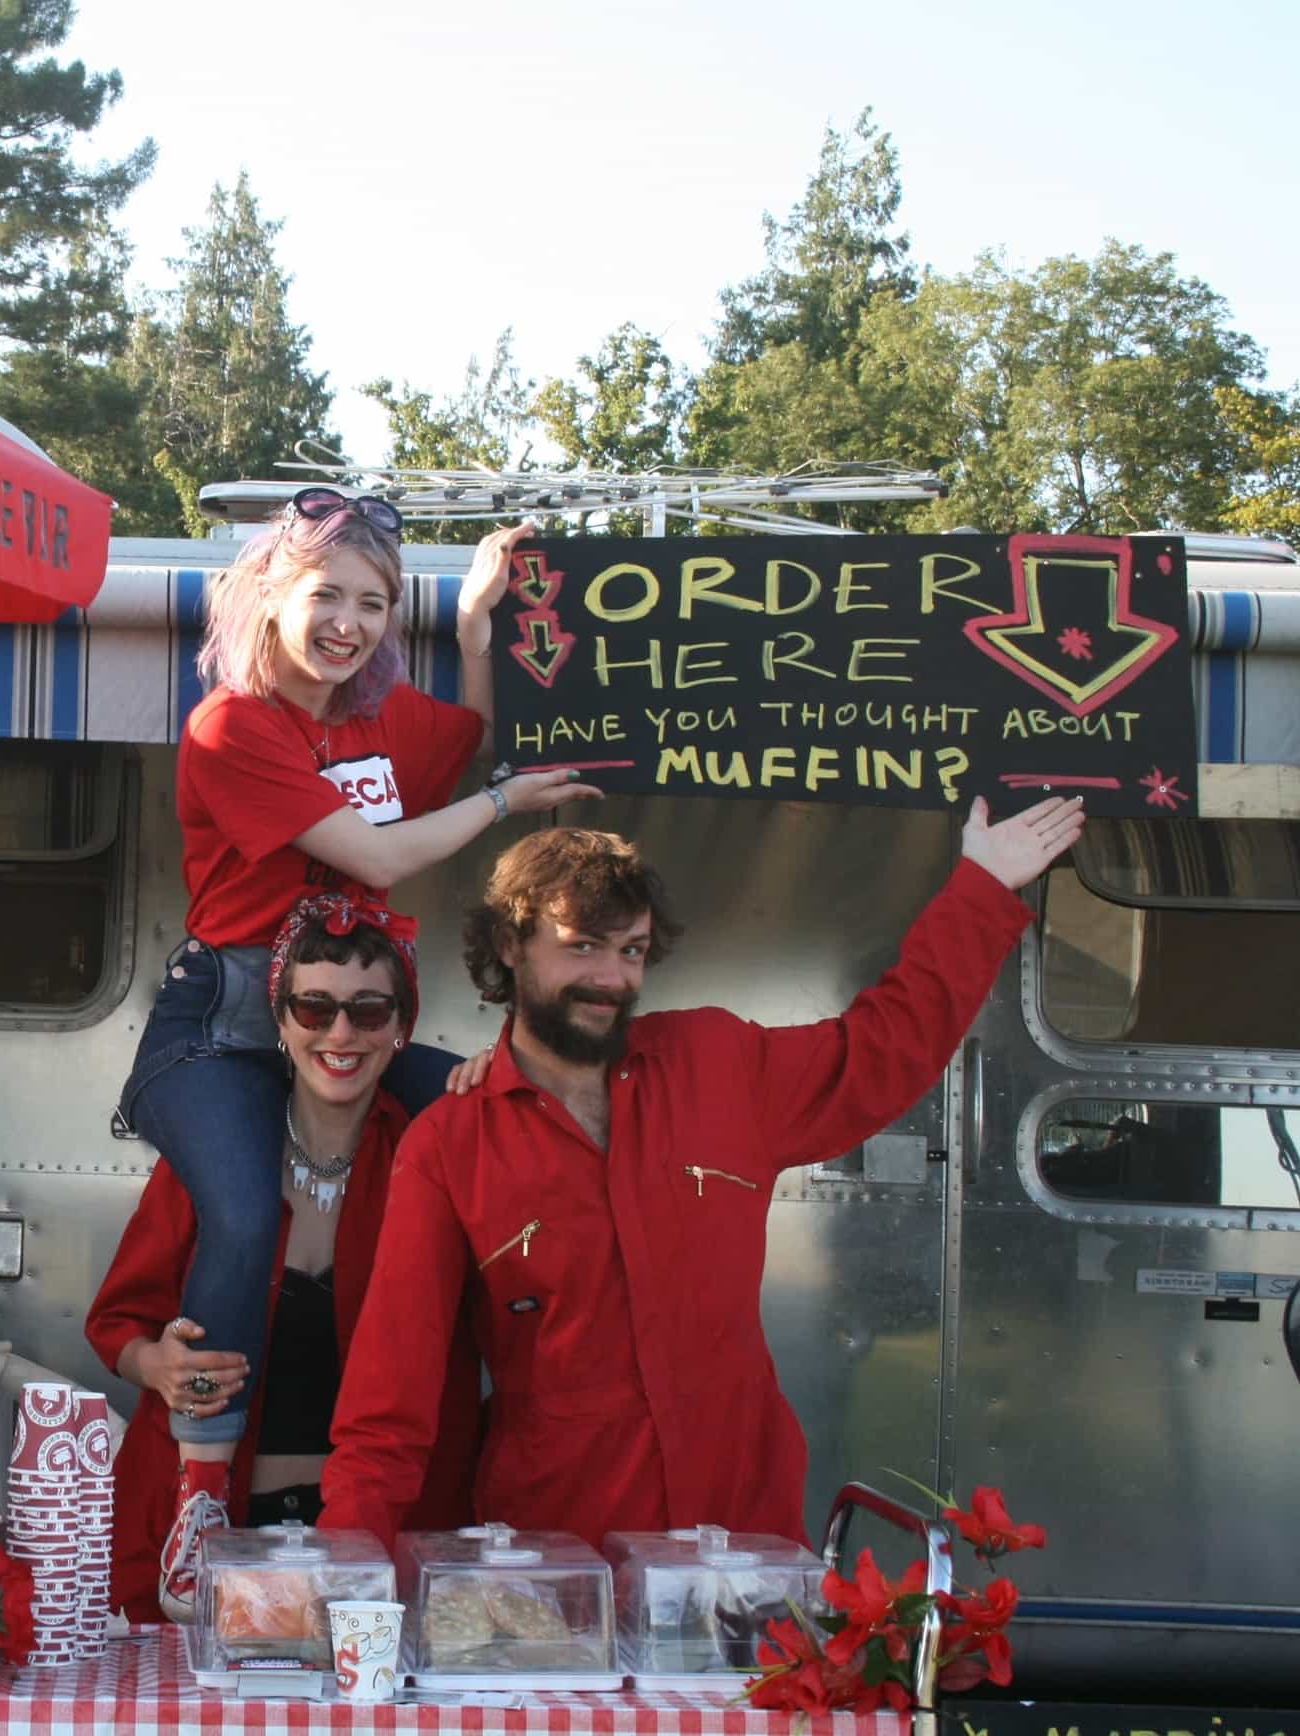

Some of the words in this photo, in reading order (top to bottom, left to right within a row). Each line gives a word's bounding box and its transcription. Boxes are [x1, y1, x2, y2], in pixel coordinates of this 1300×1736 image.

[584, 553, 1004, 622] ORDER
[594, 632, 921, 689] HERE
[516, 714, 627, 753] HAVE
[645, 704, 737, 745] YOU
[760, 702, 978, 735] THOUGHT
[1003, 711, 1140, 741] ABOUT
[657, 745, 972, 803] MUFFIN?
